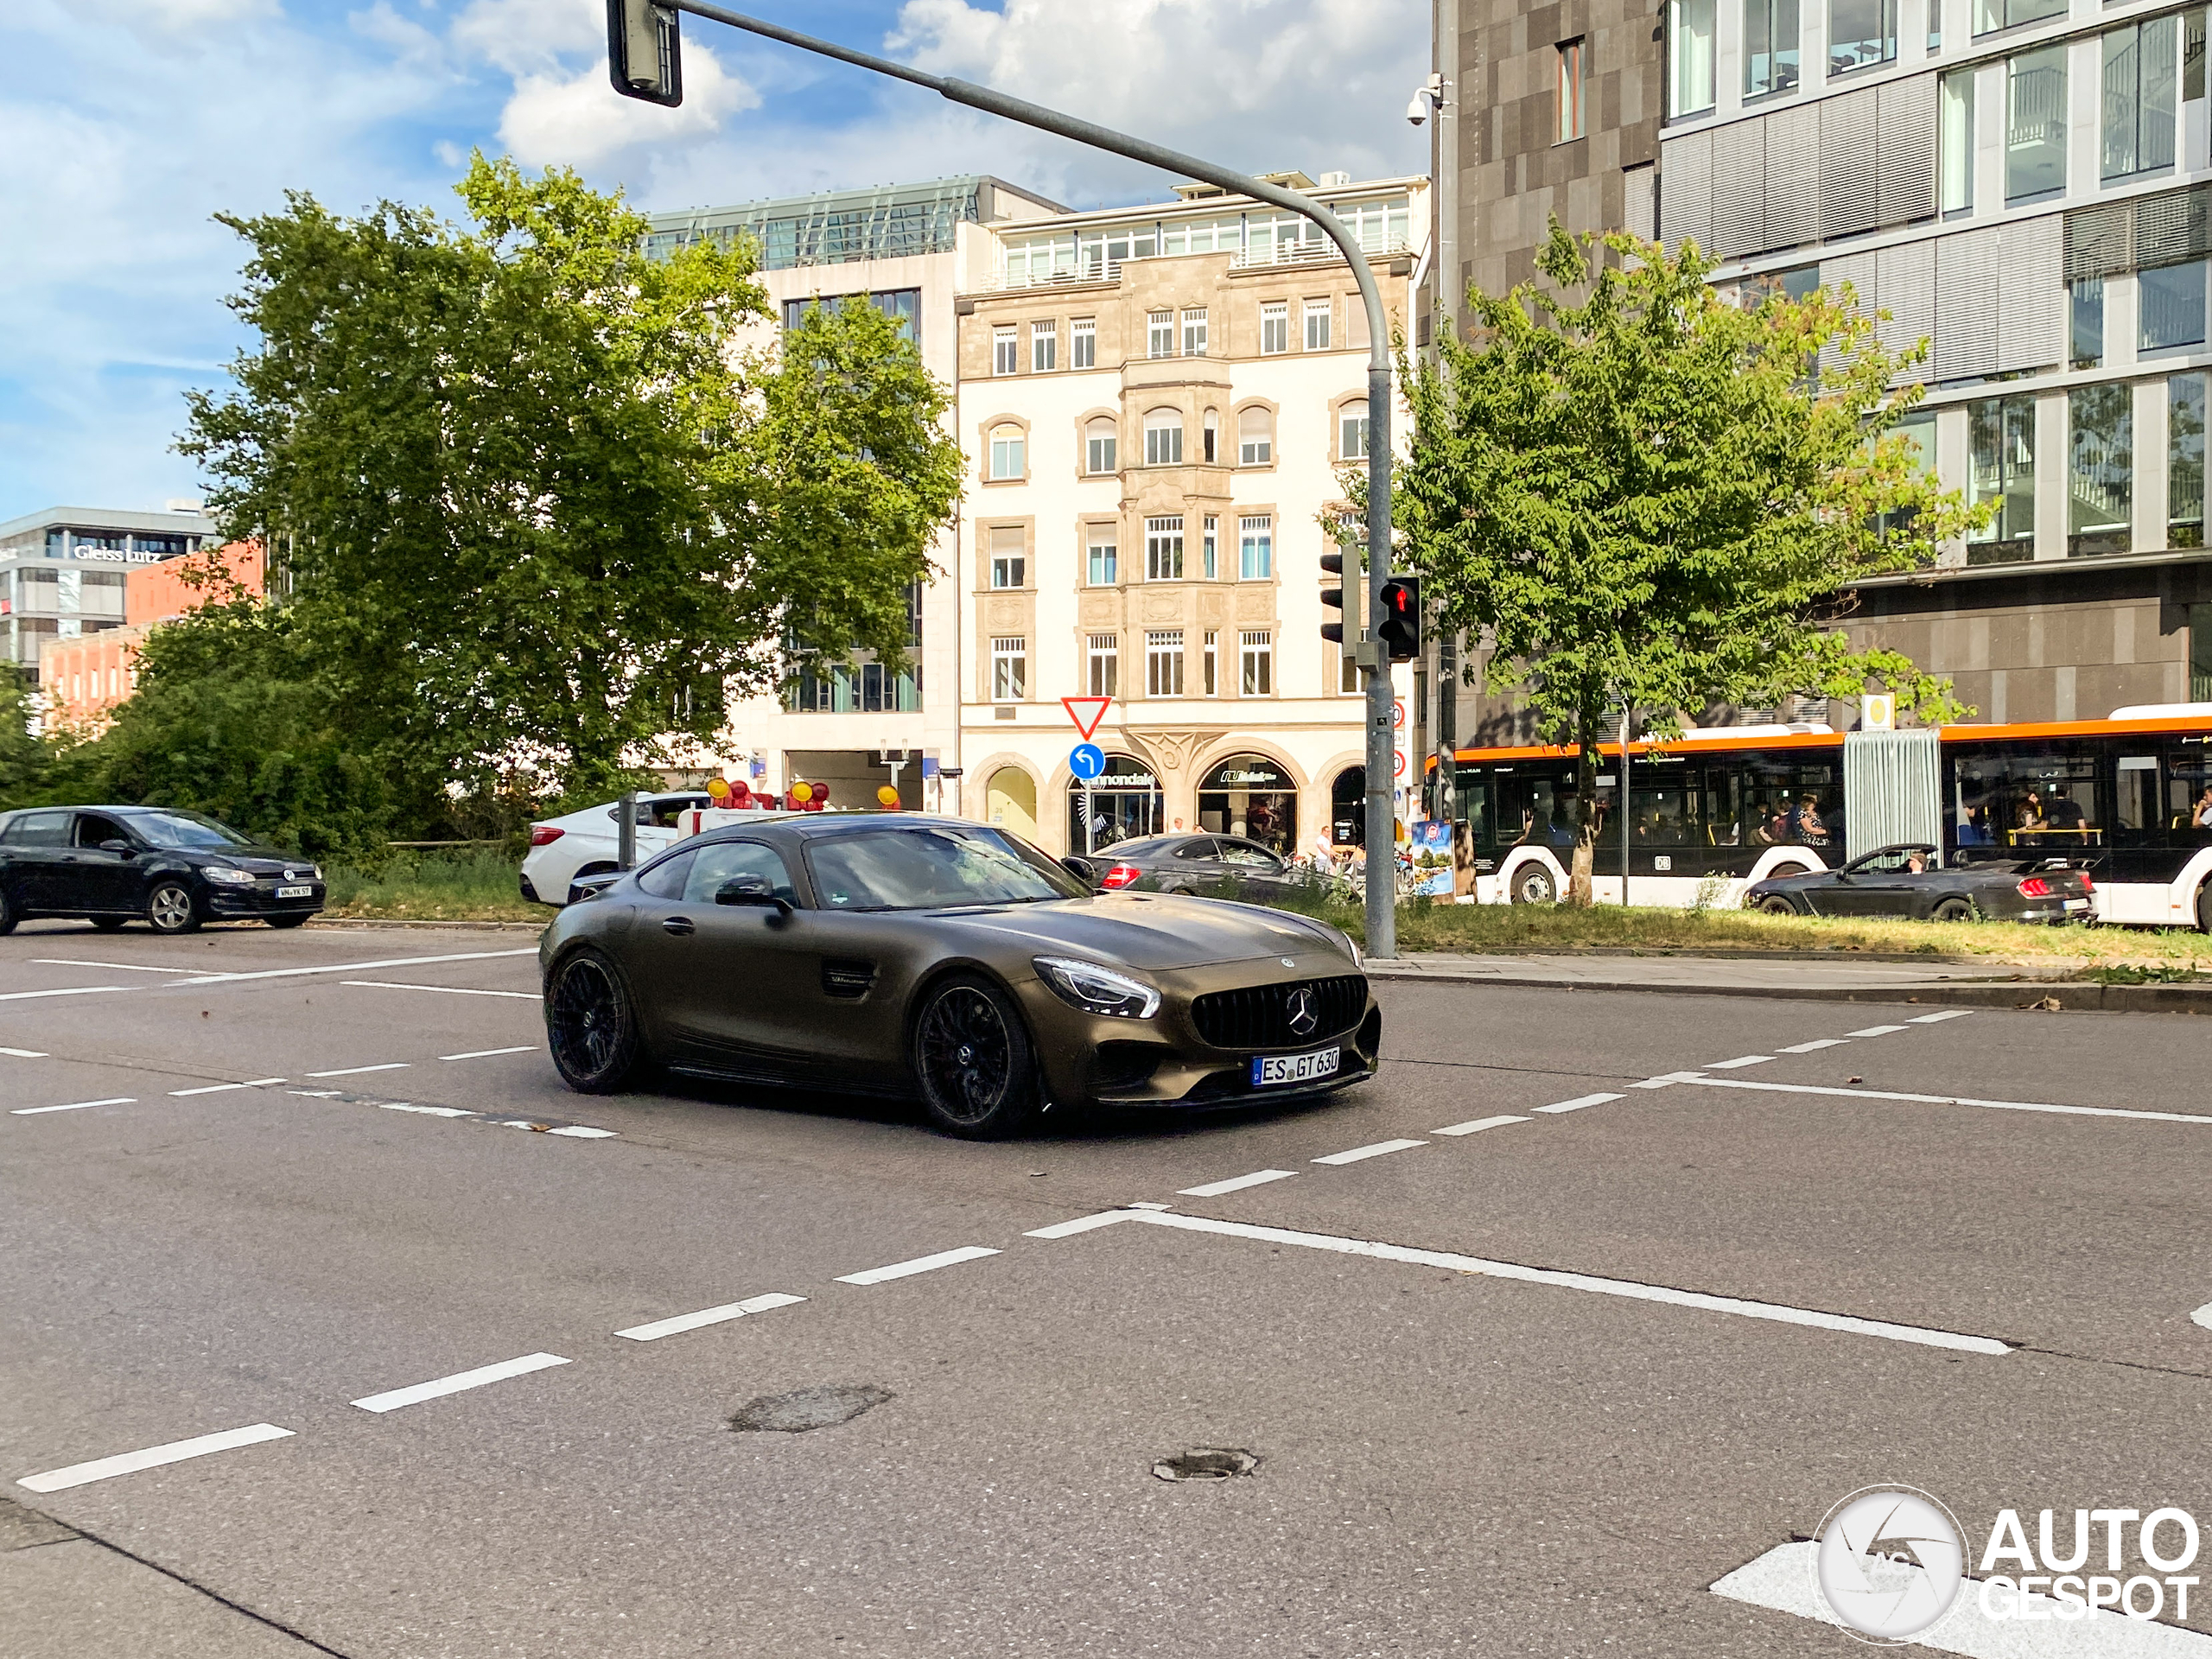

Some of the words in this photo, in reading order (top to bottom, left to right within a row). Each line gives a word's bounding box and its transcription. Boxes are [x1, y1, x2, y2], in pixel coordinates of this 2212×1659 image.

[74, 544, 124, 562] Gleiss
[125, 549, 162, 564] Lutz
[1656, 857, 1669, 868] DB
[1263, 1059, 1286, 1080] ES
[1297, 1056, 1315, 1077] GT
[1317, 1051, 1338, 1073] 630
